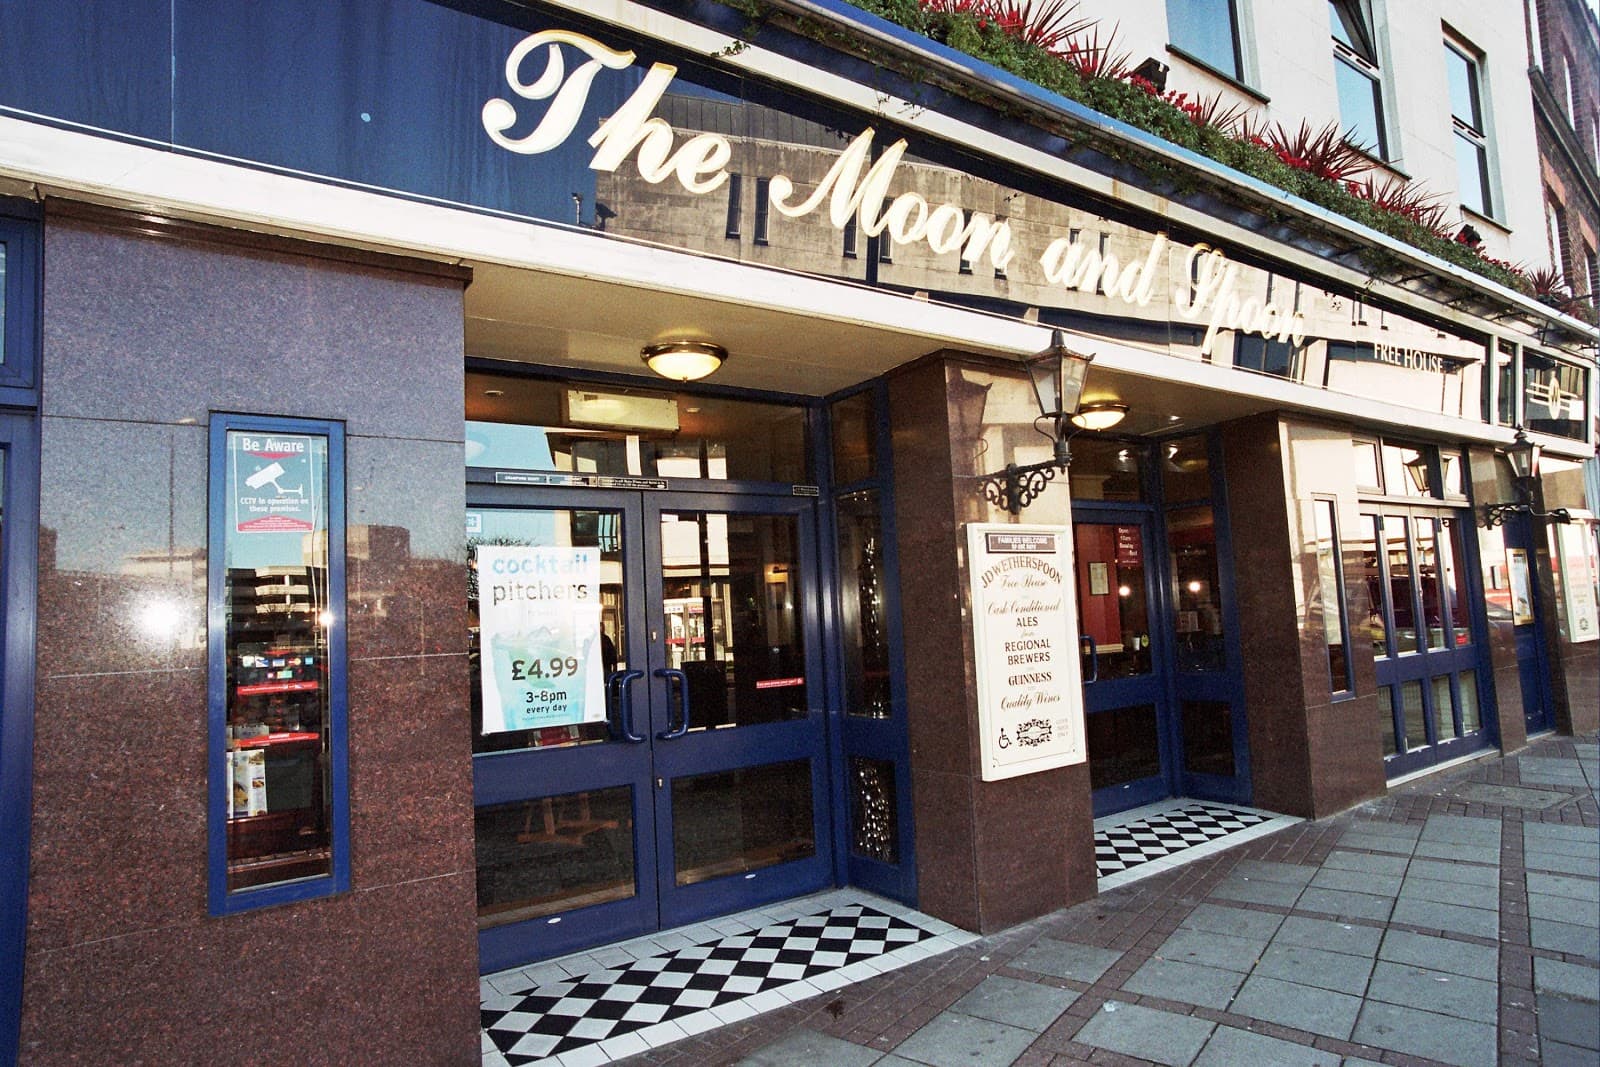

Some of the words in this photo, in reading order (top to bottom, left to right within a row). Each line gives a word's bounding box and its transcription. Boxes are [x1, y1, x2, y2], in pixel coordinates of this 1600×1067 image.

[482, 29, 731, 194] The
[769, 126, 1015, 271] Moon
[1040, 230, 1168, 307] and
[1176, 243, 1305, 356] Spoon
[1374, 342, 1402, 366] FREE
[1404, 347, 1443, 376] HOUSE
[243, 438, 260, 451] Be
[265, 438, 305, 452] Aware
[492, 553, 588, 574] cocktail
[493, 581, 588, 606] pitchers
[1010, 597, 1061, 614] Conditioned
[1016, 617, 1038, 627] ALES
[1005, 639, 1051, 652] REGIONAL
[1007, 652, 1051, 665] BREWERS
[512, 657, 578, 681] £4.99
[1008, 672, 1052, 686] GUINNESS
[526, 690, 567, 704] 3-8pm
[1000, 694, 1033, 711] Quality
[1035, 691, 1061, 703] Wines
[526, 705, 550, 714] every
[552, 703, 567, 713] day
